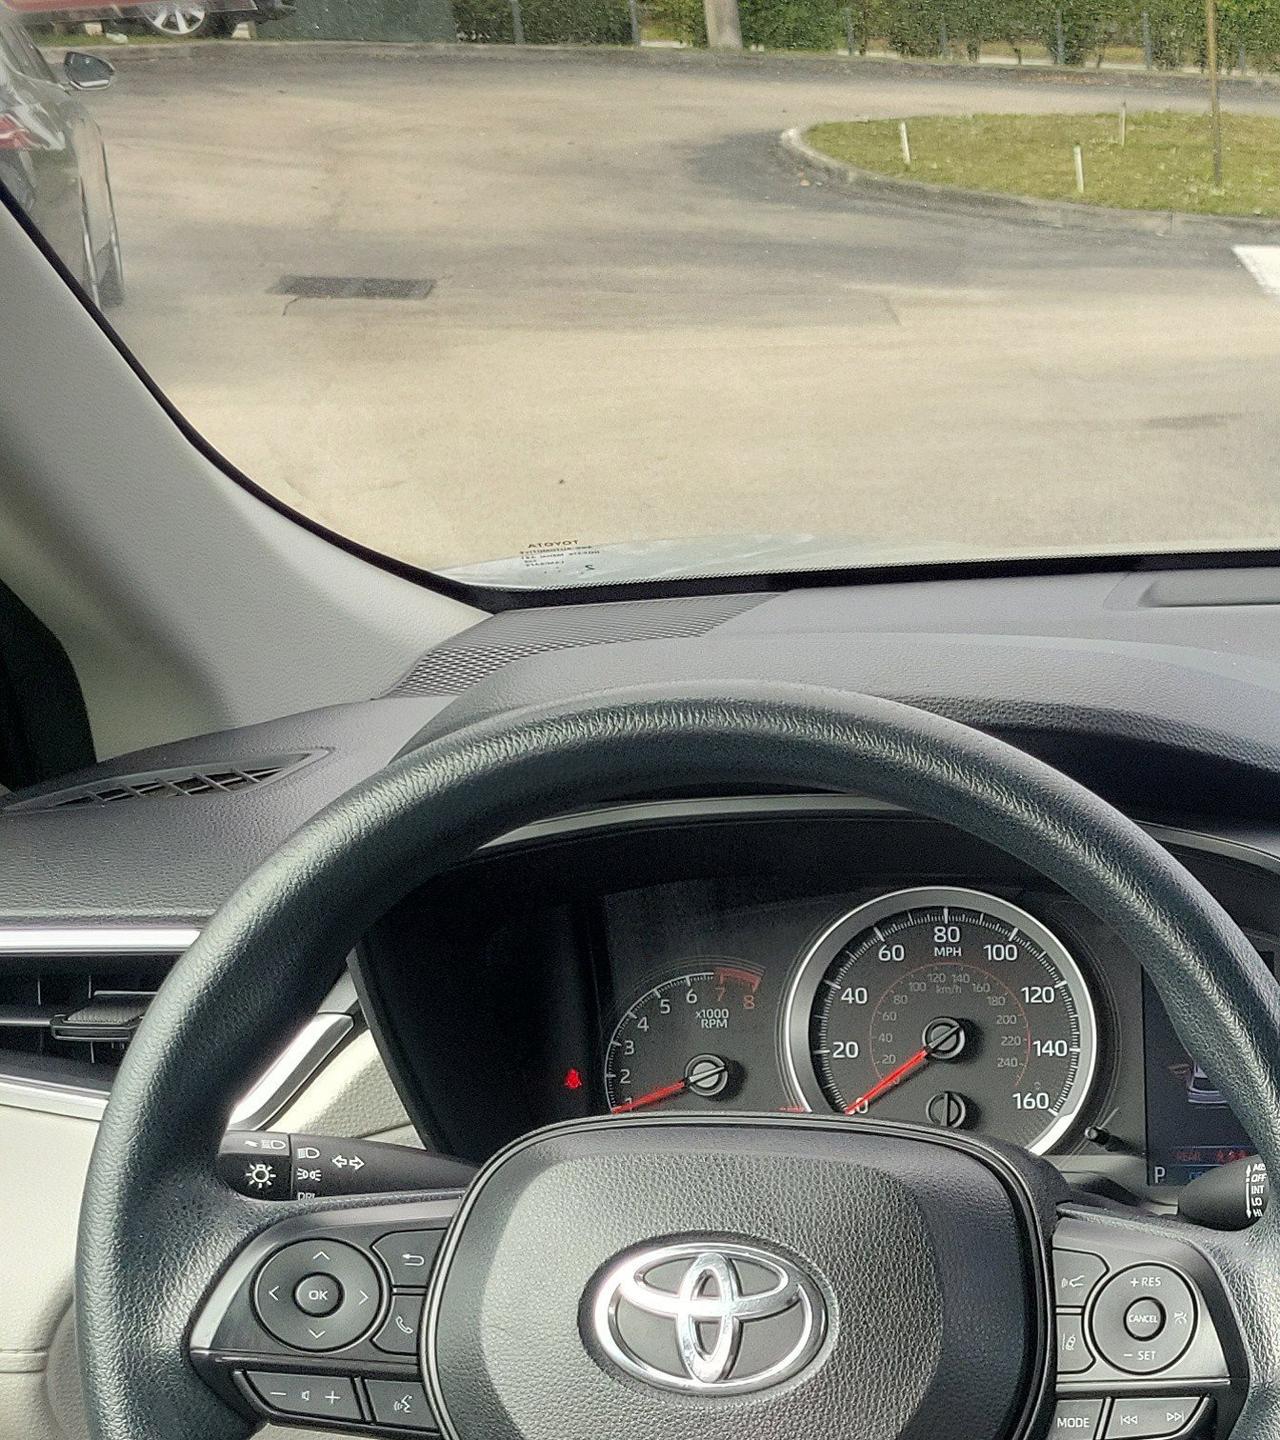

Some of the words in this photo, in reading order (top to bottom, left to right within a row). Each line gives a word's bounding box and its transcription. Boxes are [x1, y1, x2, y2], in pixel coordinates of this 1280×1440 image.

[933, 926, 961, 943] 80
[878, 945, 905, 962] 60
[934, 947, 962, 957] MPH
[983, 944, 1018, 962] 100
[927, 973, 946, 983] 120
[952, 973, 970, 984] 140
[686, 990, 698, 1004] 6
[715, 988, 726, 1001] 7
[840, 987, 868, 1004] 40
[1020, 986, 1055, 1004] 120
[659, 1000, 671, 1014] 5
[743, 995, 755, 1009] 8
[695, 1008, 729, 1019] x1000
[636, 1017, 650, 1031] 4
[700, 1018, 728, 1029] RPM
[624, 1040, 635, 1055] 3
[832, 1041, 860, 1058] 20
[1032, 1040, 1068, 1057] 140
[619, 1070, 631, 1084] 2
[1012, 1092, 1050, 1110] 160
[1154, 1166, 1166, 1183] P
[1251, 1172, 1268, 1183] OFF
[1251, 1185, 1265, 1195] INT
[1251, 1197, 1263, 1207] LO
[1141, 1277, 1162, 1287] RES
[308, 1289, 329, 1301] OK
[1128, 1314, 1159, 1323] CANCEL
[1136, 1351, 1157, 1361] SET
[1057, 1417, 1090, 1428] MODE
